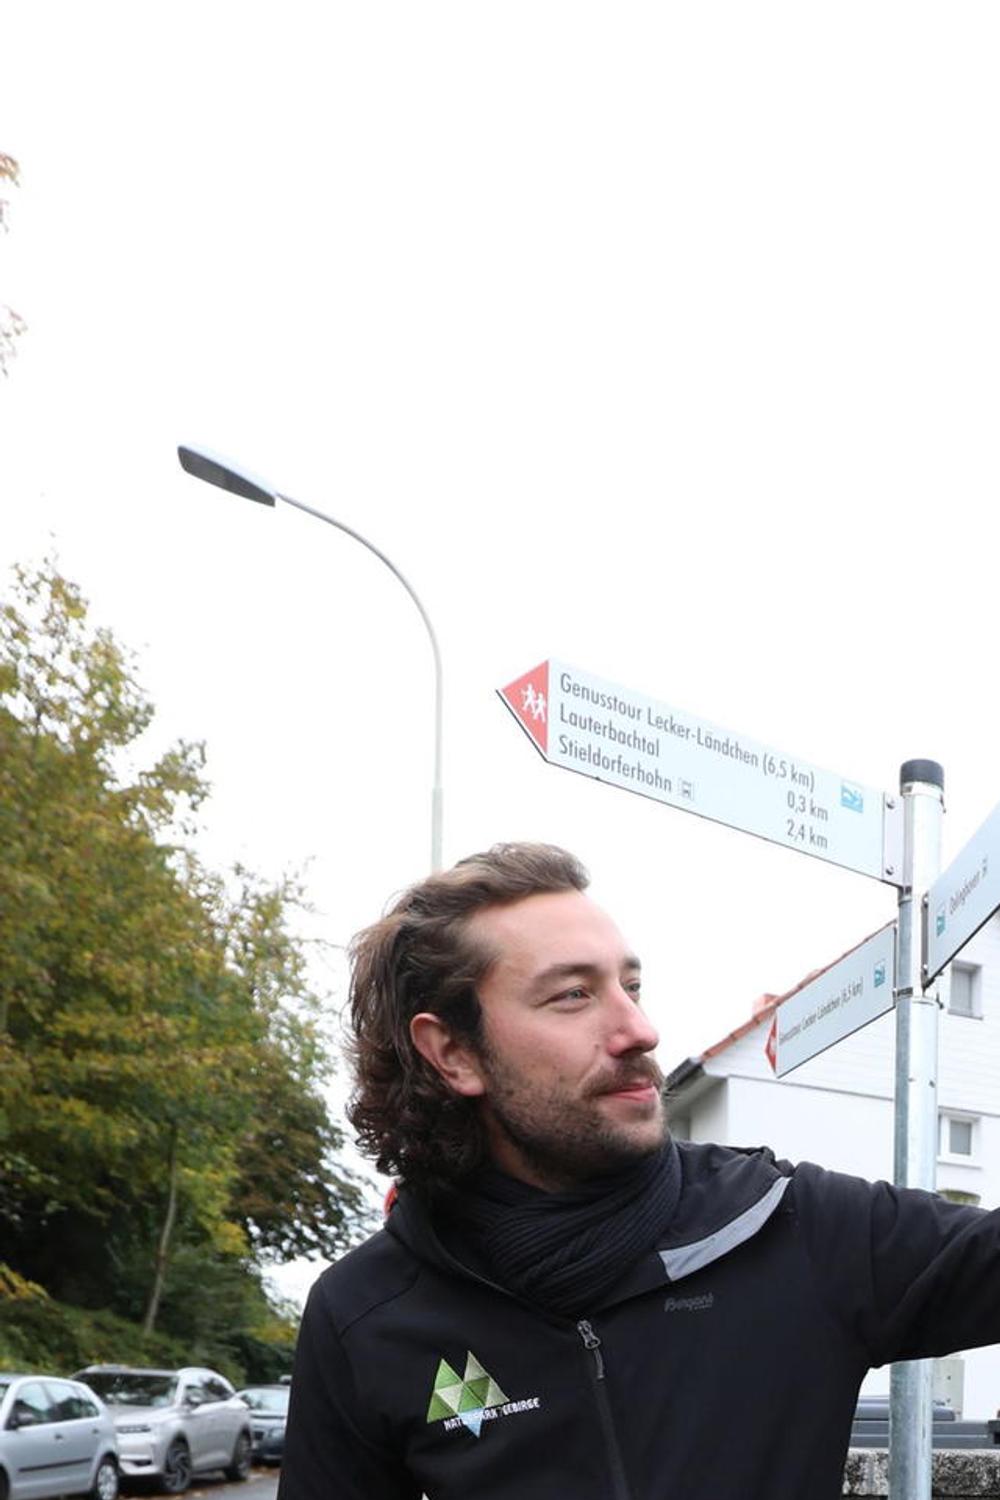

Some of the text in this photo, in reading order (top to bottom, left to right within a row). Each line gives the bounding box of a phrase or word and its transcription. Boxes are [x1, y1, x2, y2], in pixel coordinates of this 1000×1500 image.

[560, 702, 660, 757] Lauterbachtal
[560, 673, 815, 793] Genusstour Lecker-Ländchen (6,5 km)
[559, 733, 672, 793] Stieldorferhohn
[786, 789, 828, 822] 0,3 km
[786, 817, 827, 849] 2,4 km
